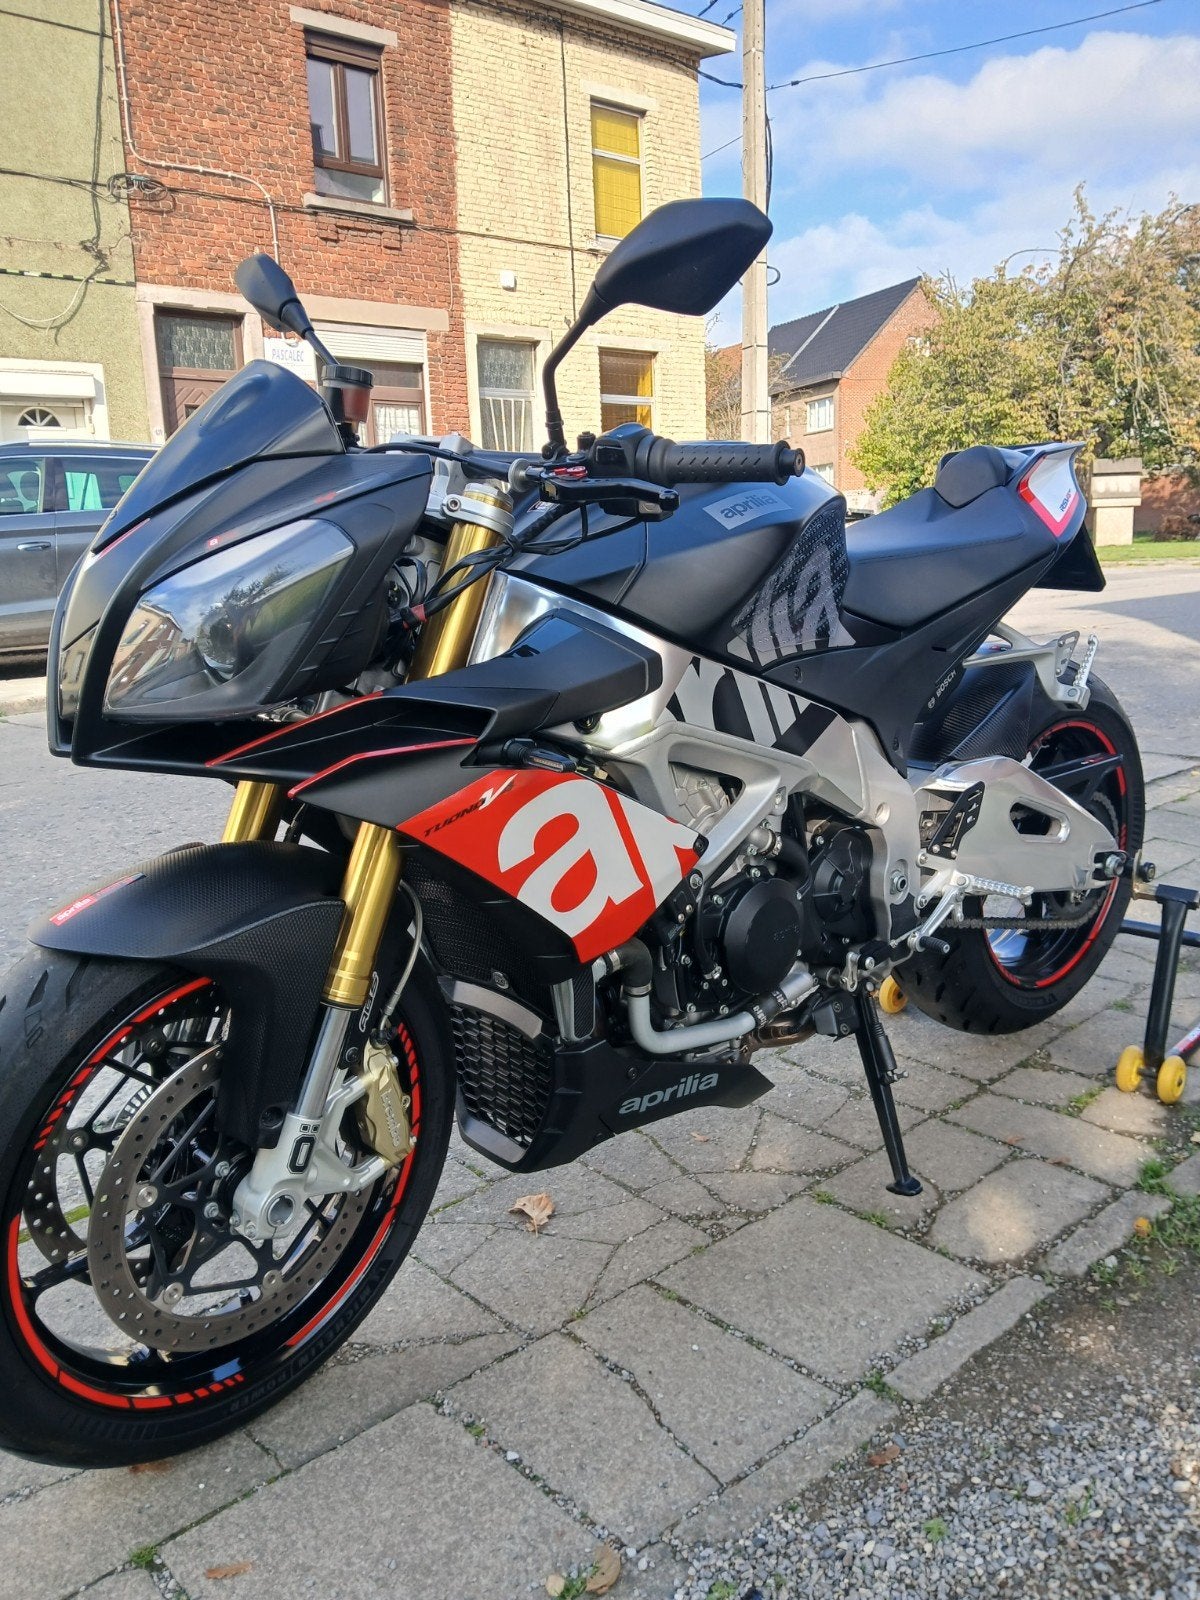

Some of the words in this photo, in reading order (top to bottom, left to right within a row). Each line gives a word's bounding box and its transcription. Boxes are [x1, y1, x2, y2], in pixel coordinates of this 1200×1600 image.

[720, 495, 778, 518] aprilia
[936, 669, 956, 698] BOSCH
[57, 898, 91, 920] aprilia
[619, 1072, 719, 1114] aprilia
[380, 1088, 401, 1148] brembo
